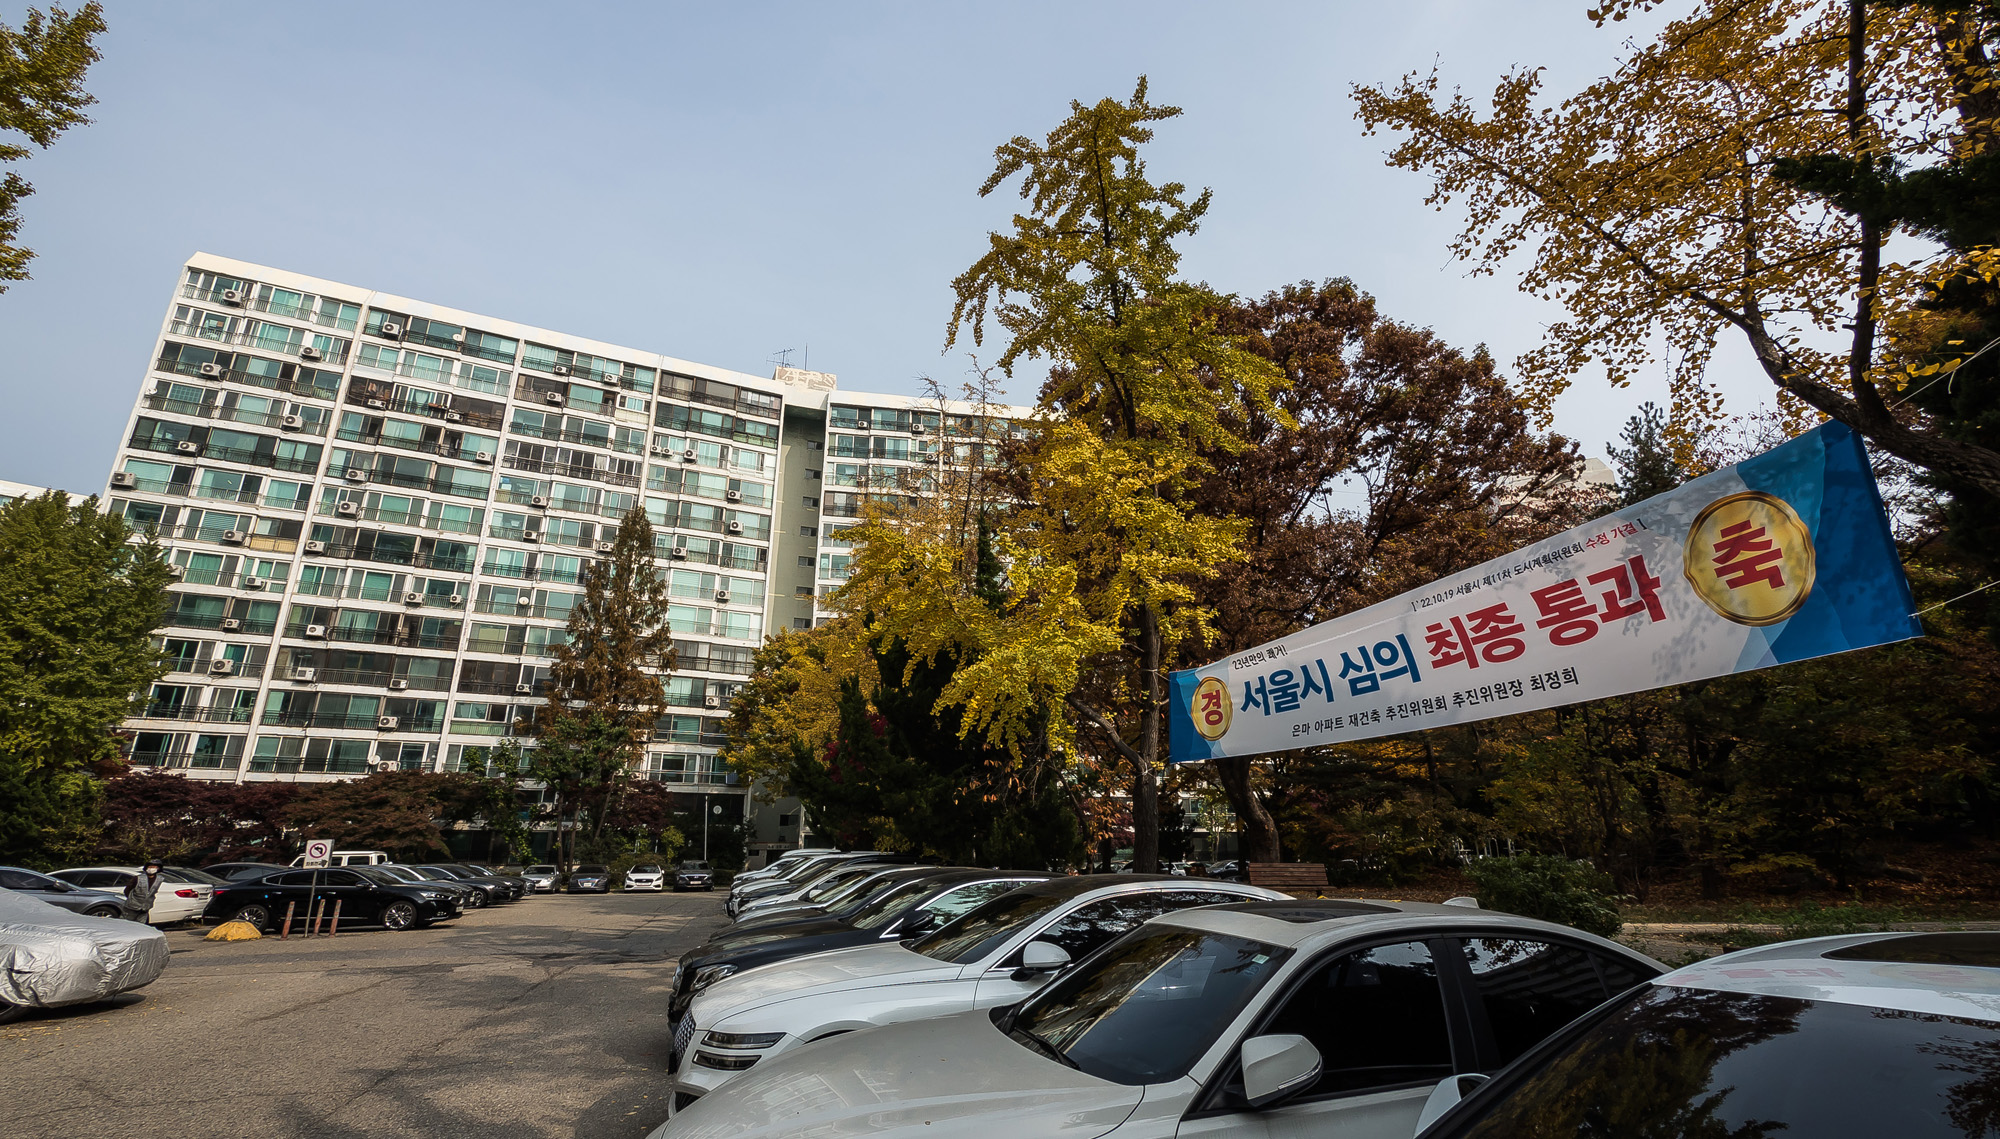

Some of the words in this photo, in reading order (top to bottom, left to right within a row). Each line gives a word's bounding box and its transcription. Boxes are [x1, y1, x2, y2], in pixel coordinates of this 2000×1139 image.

[1455, 578, 1481, 598] 서울시
[1482, 569, 1512, 587] 제11차
[1513, 542, 1585, 576] 도시계획위원회
[1585, 533, 1611, 549] 수정
[1712, 520, 1785, 589] 축
[1232, 650, 1267, 670] 23년만의
[1240, 658, 1335, 716] 서울시
[1338, 633, 1421, 697] 심의
[1424, 601, 1526, 670] 최종
[1530, 554, 1666, 646] 통과
[1201, 689, 1224, 726] 경
[1291, 723, 1311, 737] 은마
[1314, 716, 1345, 733] 아파트
[1348, 708, 1381, 727] 재건축
[1385, 695, 1448, 721] 추진위원회
[1452, 678, 1524, 708] 추진위원장
[1530, 666, 1579, 692] 최정희
